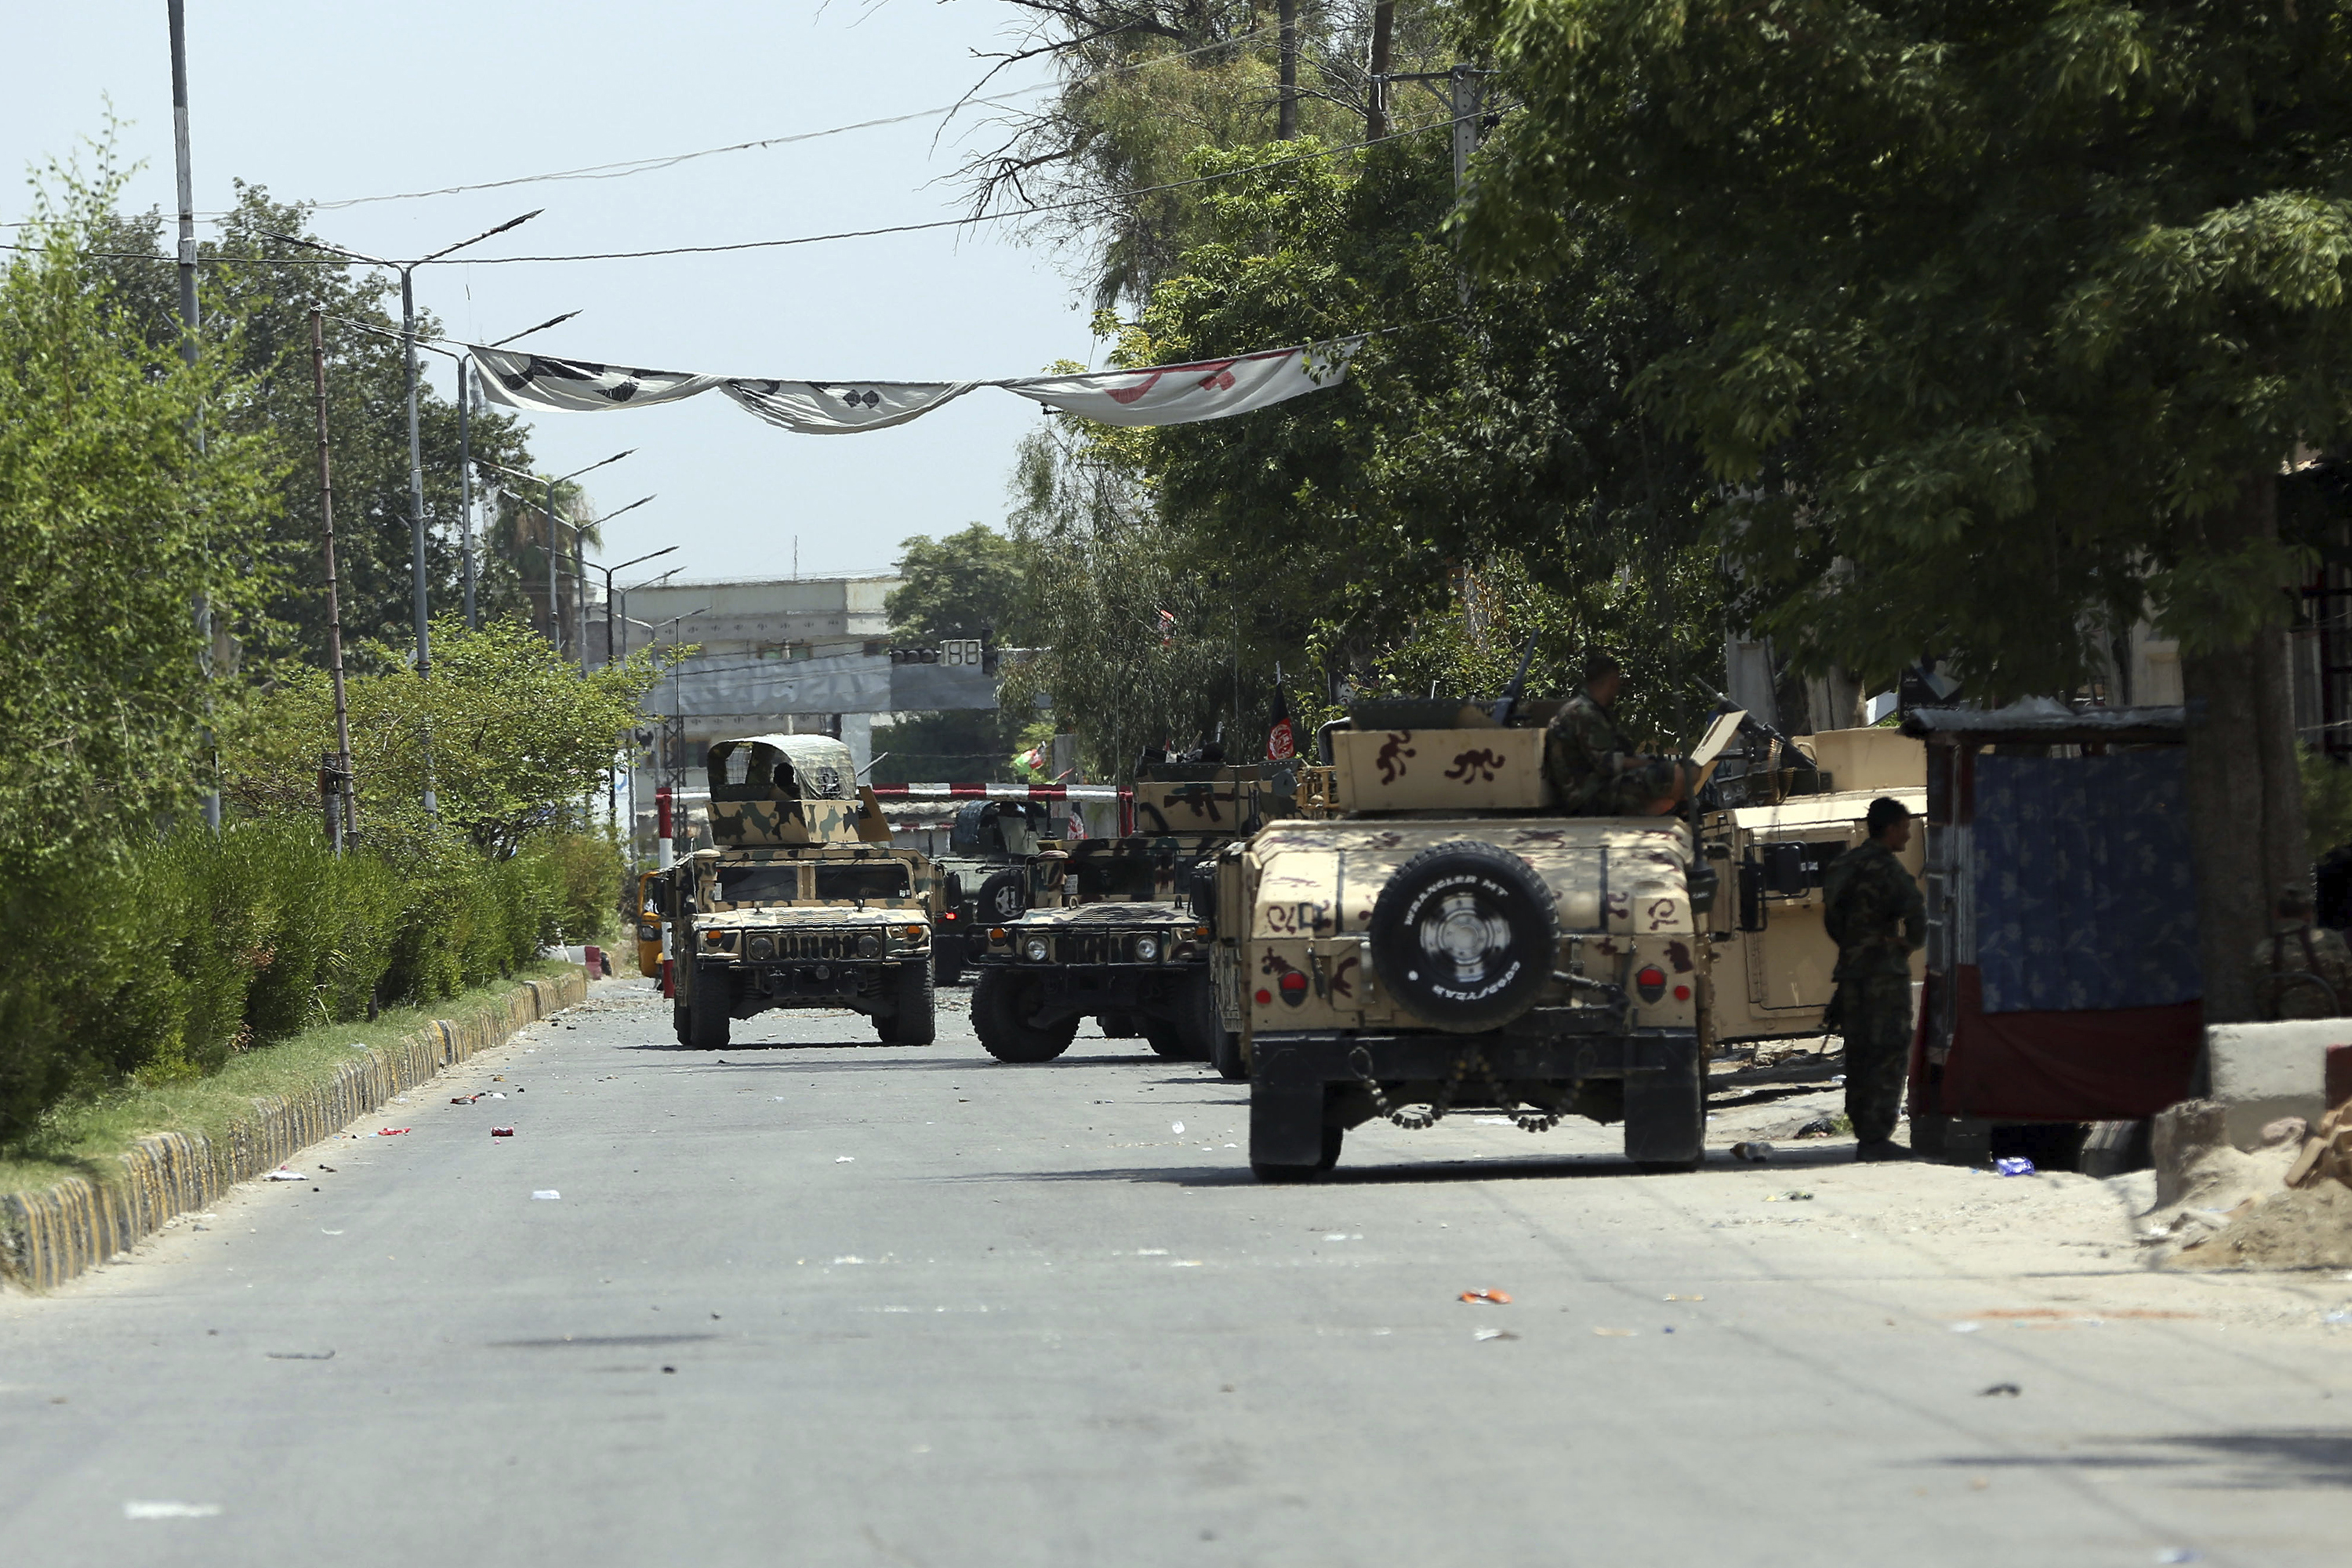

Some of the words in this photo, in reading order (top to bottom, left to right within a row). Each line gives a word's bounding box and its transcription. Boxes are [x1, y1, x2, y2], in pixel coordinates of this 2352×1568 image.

[1403, 875, 1478, 925] WRANGLER
[1482, 879, 1509, 897] MT
[1432, 960, 1521, 1001] GOODYEAR
